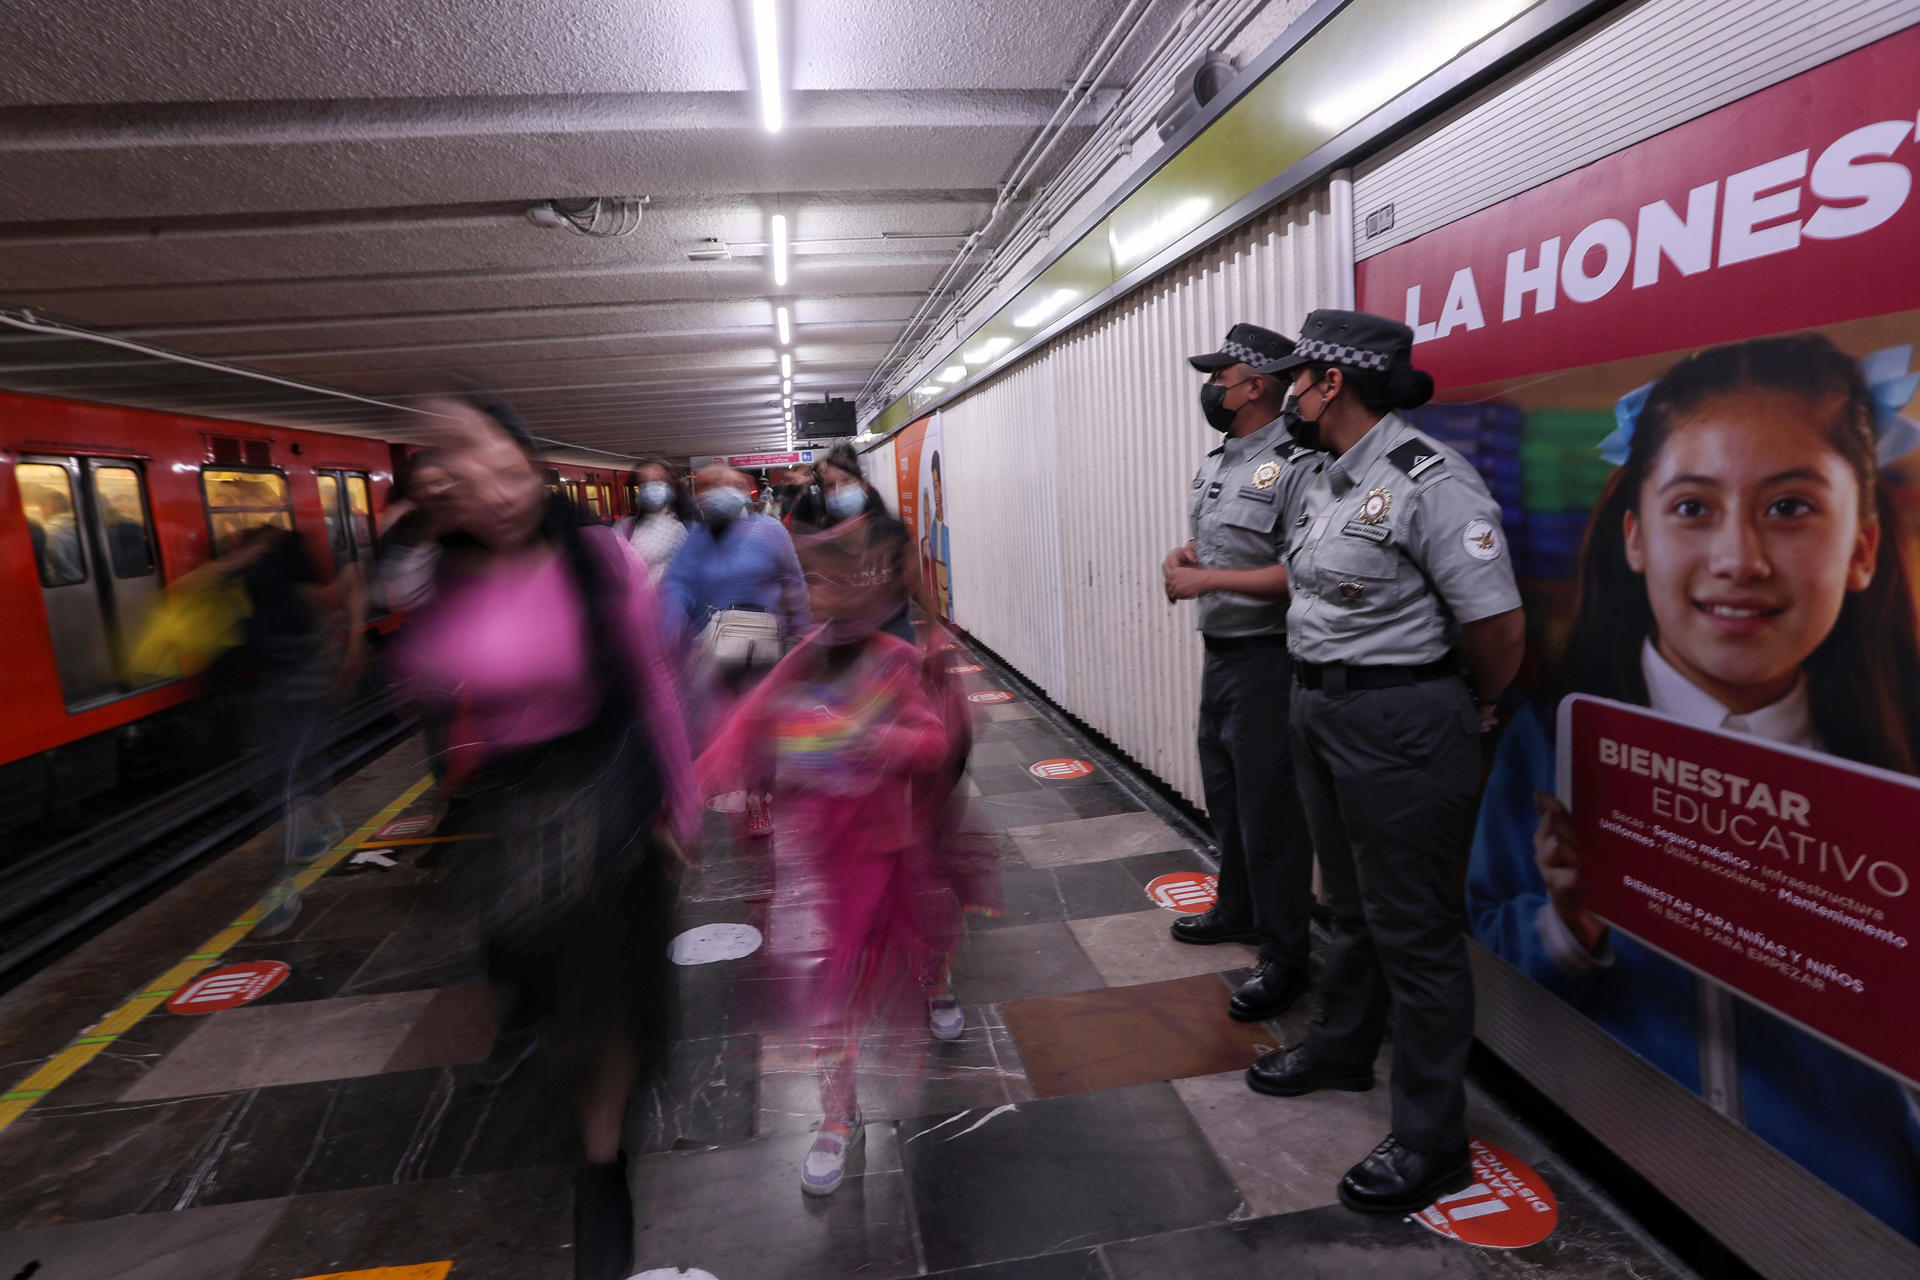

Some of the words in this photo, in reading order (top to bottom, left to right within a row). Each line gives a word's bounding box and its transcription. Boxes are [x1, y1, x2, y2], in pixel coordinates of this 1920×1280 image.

[1405, 266, 1486, 346] LA
[1502, 110, 1920, 324] HONES
[1599, 737, 1811, 827] BIENESTAR
[1599, 818, 1656, 848] Uniformes
[1700, 860, 1768, 892] escolares
[1777, 887, 1909, 949] Mantenimiento
[1652, 786, 1910, 898] EDUCATIVO
[1652, 825, 1698, 850] Seguro
[1698, 843, 1751, 870] médico
[1760, 865, 1886, 923] Infraestructura
[1622, 874, 1694, 915] BIENESTAR
[1694, 906, 1735, 935] PARA
[1736, 926, 1788, 959] NIÑAS
[1790, 949, 1804, 964] Y
[1804, 957, 1865, 994] NIÑOS
[1647, 899, 1664, 915] MI
[1664, 908, 1702, 934] BECA
[1702, 926, 1744, 954] PARA
[1745, 946, 1827, 993] EMPEZAR
[1469, 1140, 1552, 1213] DISTANCIA
[1471, 1159, 1515, 1198] SANA
